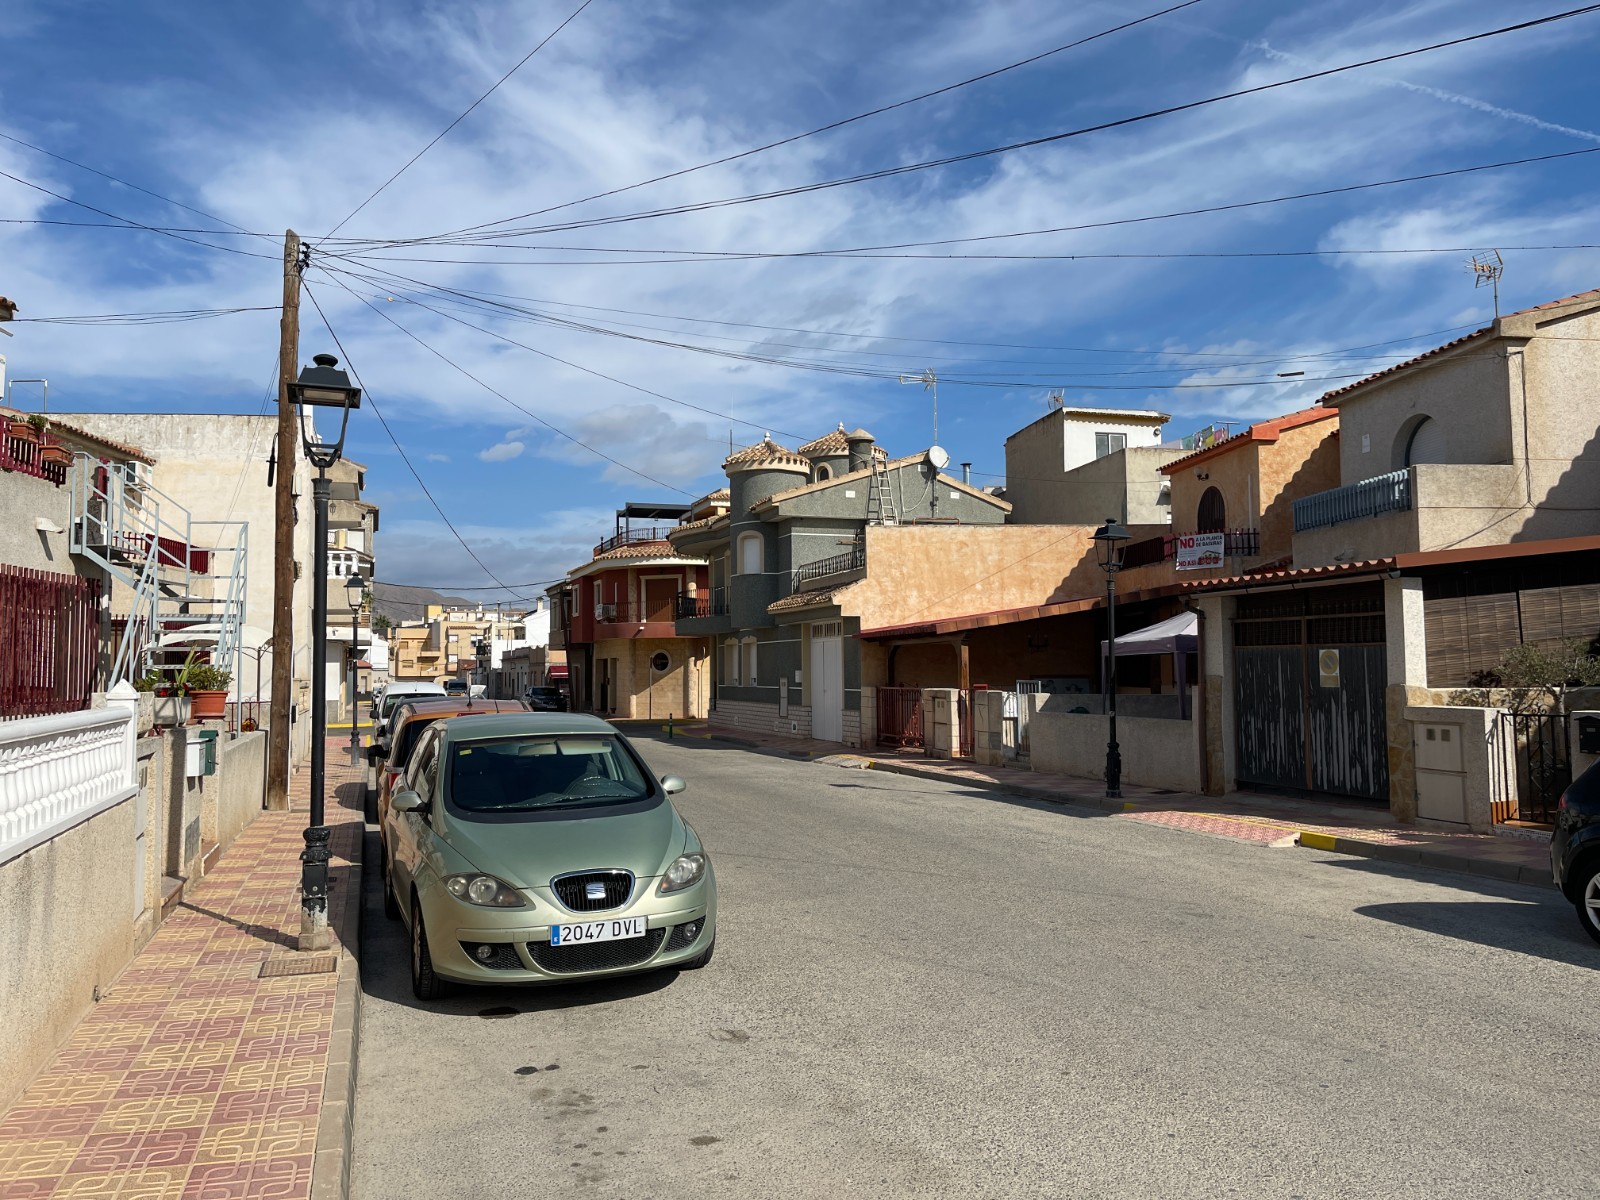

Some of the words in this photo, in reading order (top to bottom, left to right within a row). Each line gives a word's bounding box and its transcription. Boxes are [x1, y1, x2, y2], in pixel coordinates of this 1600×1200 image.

[1180, 538, 1194, 548] NO
[562, 922, 605, 942] 2047
[612, 919, 642, 937] DVL
